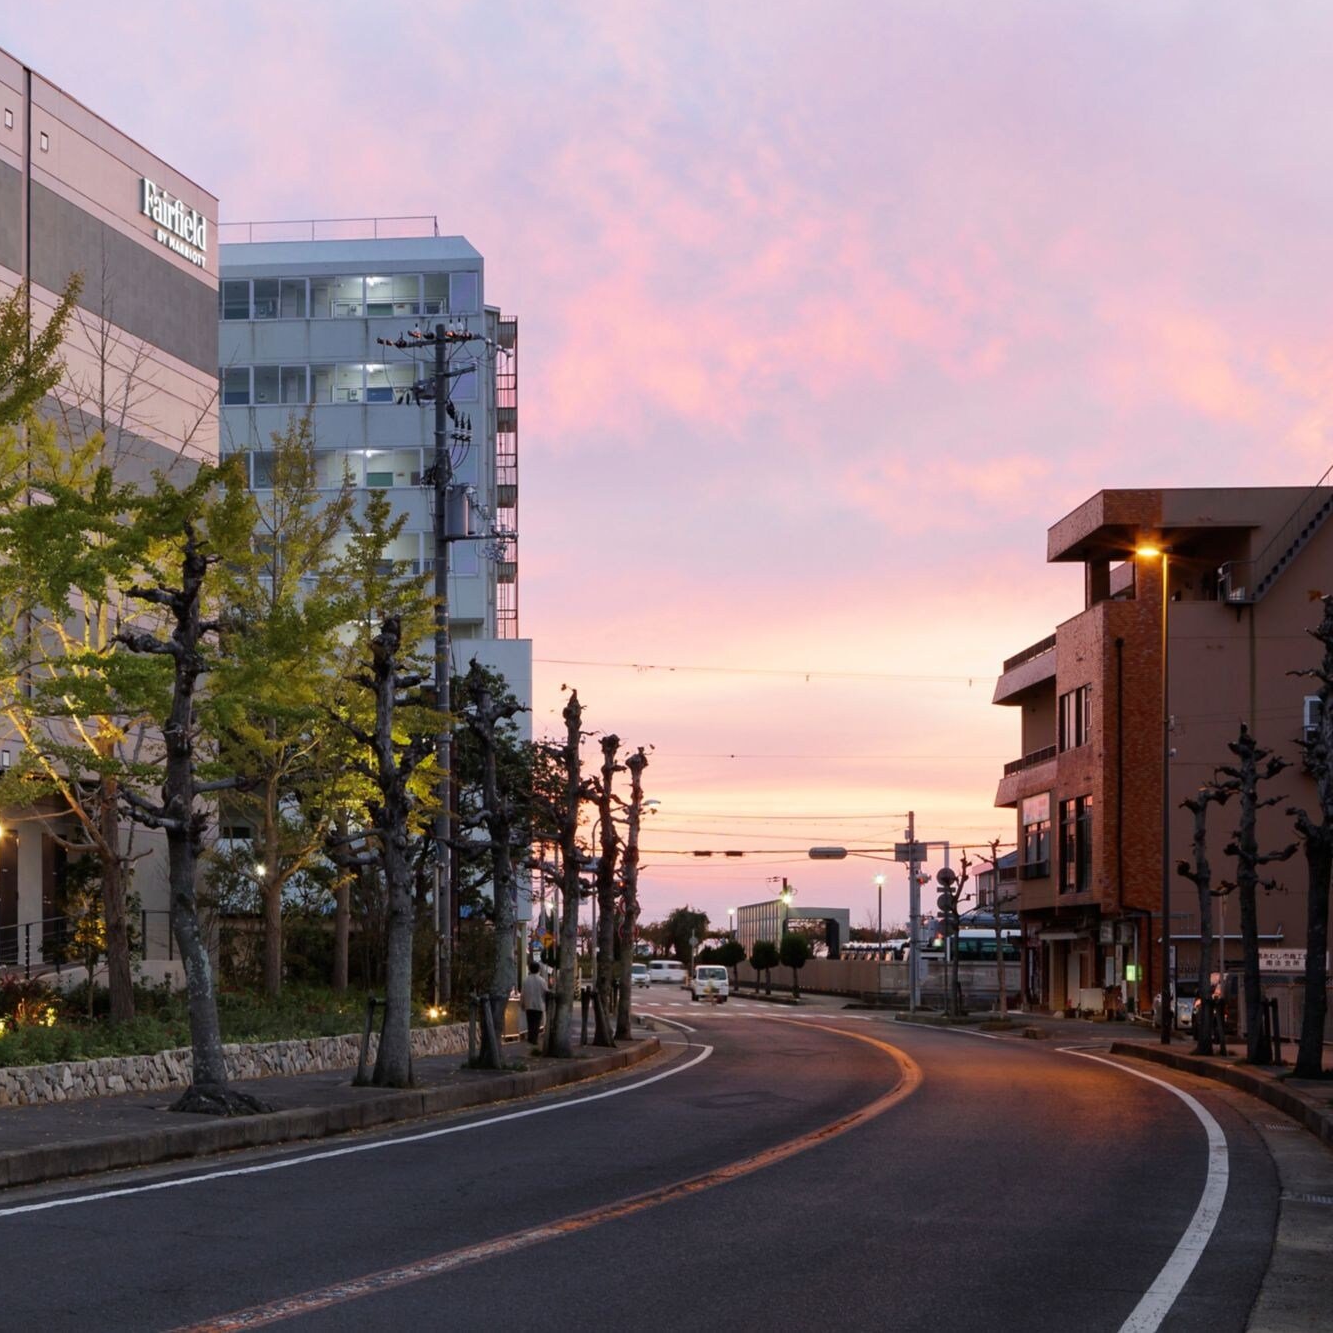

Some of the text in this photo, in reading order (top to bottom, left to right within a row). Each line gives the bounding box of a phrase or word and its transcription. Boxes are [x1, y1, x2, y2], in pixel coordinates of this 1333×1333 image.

[143, 177, 207, 252] Fairfield
[156, 228, 206, 268] BY MARRIOTT
